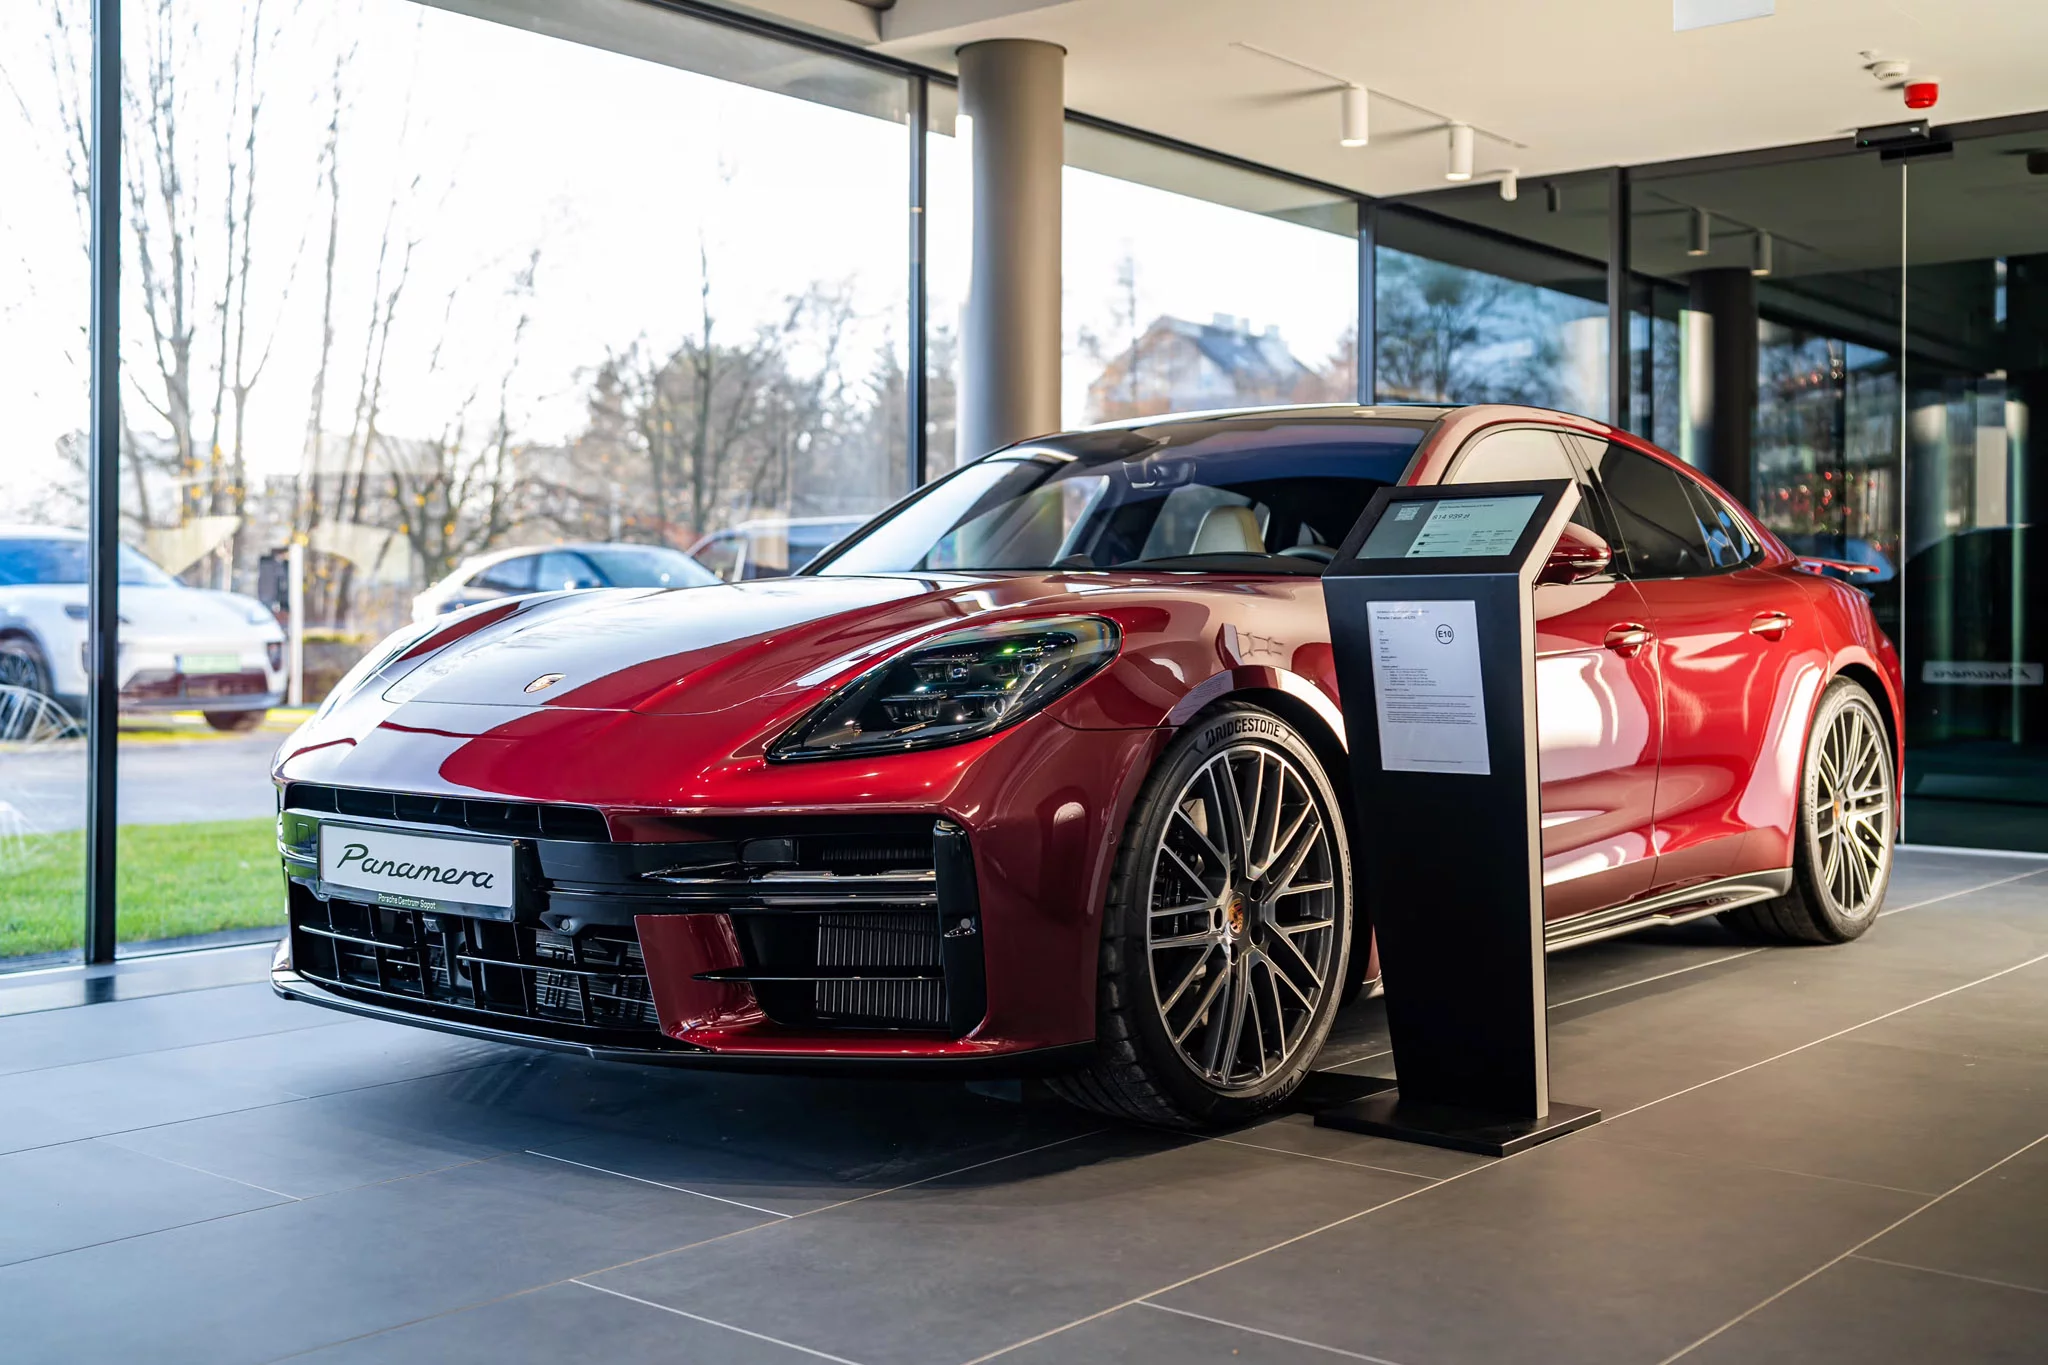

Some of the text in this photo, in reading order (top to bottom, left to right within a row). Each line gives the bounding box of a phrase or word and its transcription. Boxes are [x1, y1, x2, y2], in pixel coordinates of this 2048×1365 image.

[1438, 630, 1452, 638] E10
[1205, 718, 1280, 749] BRIDGESTONE
[336, 843, 494, 889] Panamera
[378, 893, 436, 910] Porsche Centrum Sopot
